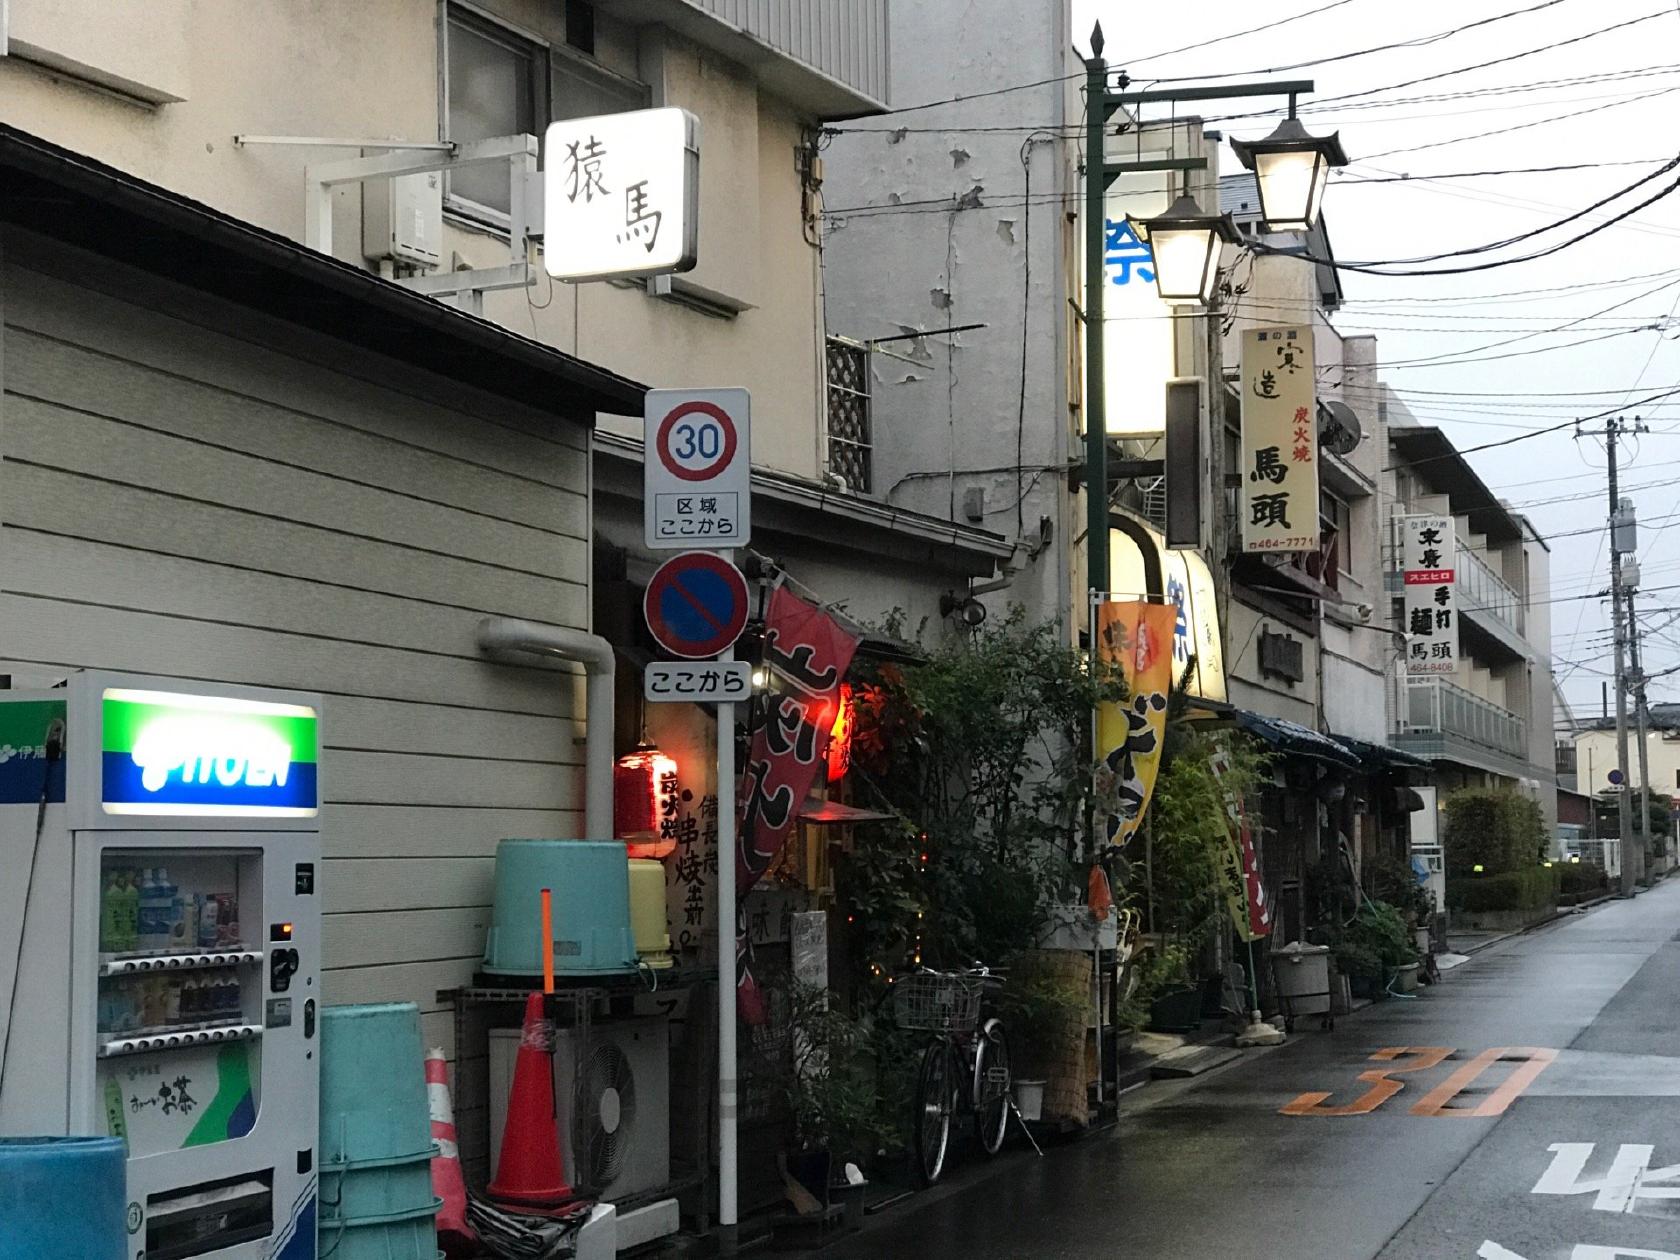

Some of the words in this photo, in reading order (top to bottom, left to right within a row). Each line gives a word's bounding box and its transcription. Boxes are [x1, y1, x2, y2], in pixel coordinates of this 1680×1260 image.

[563, 135, 662, 253] 猿馬
[675, 423, 719, 459] 30
[1292, 406, 1312, 463] 炭火焼
[1250, 446, 1291, 529] 馬頭
[677, 497, 717, 514] 区域
[660, 517, 733, 535] ここから
[1409, 572, 1450, 581] スエヒロ
[1433, 585, 1452, 629] 手打
[1410, 641, 1453, 661] 馬頭
[651, 672, 745, 693] ここから
[18, 744, 61, 761] 伊藤
[1278, 1046, 1560, 1117] 30
